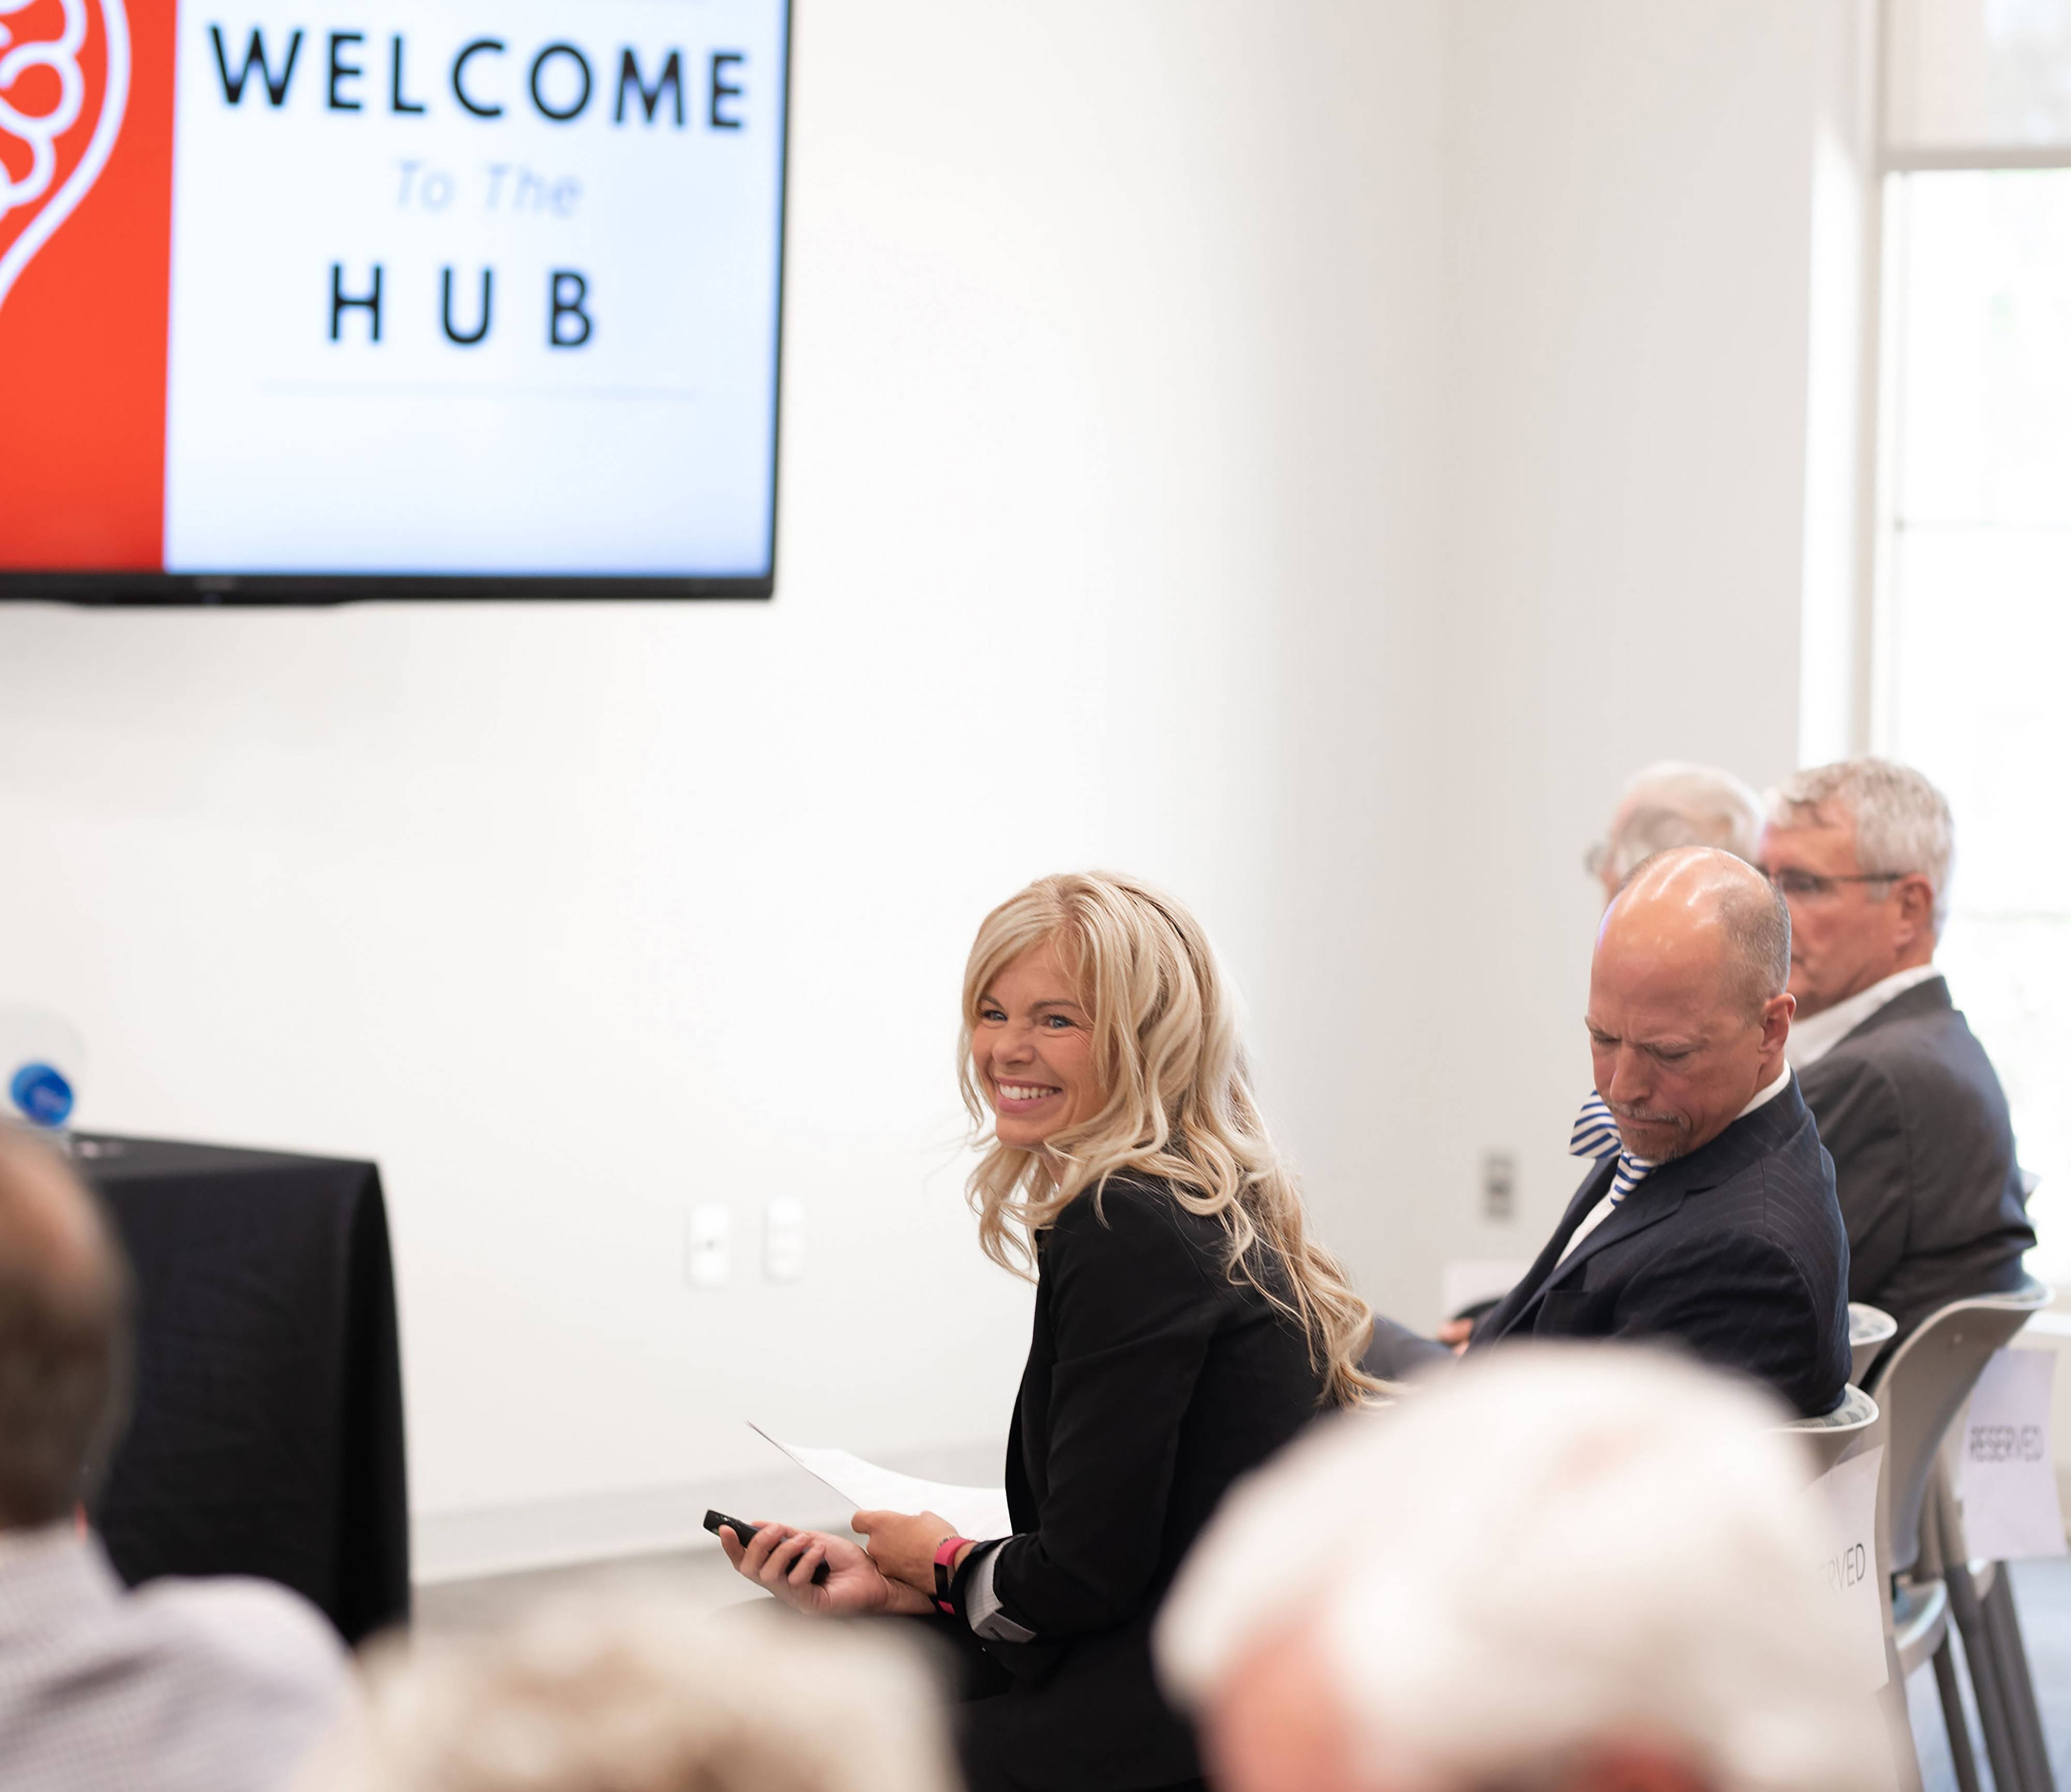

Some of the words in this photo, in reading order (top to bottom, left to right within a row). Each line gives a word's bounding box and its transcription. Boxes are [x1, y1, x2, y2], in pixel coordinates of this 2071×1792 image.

[209, 24, 744, 130] WELCOME
[391, 157, 456, 213] To
[484, 159, 585, 221] The
[330, 264, 593, 348] HUB
[1971, 1425, 2045, 1462] RESERVED
